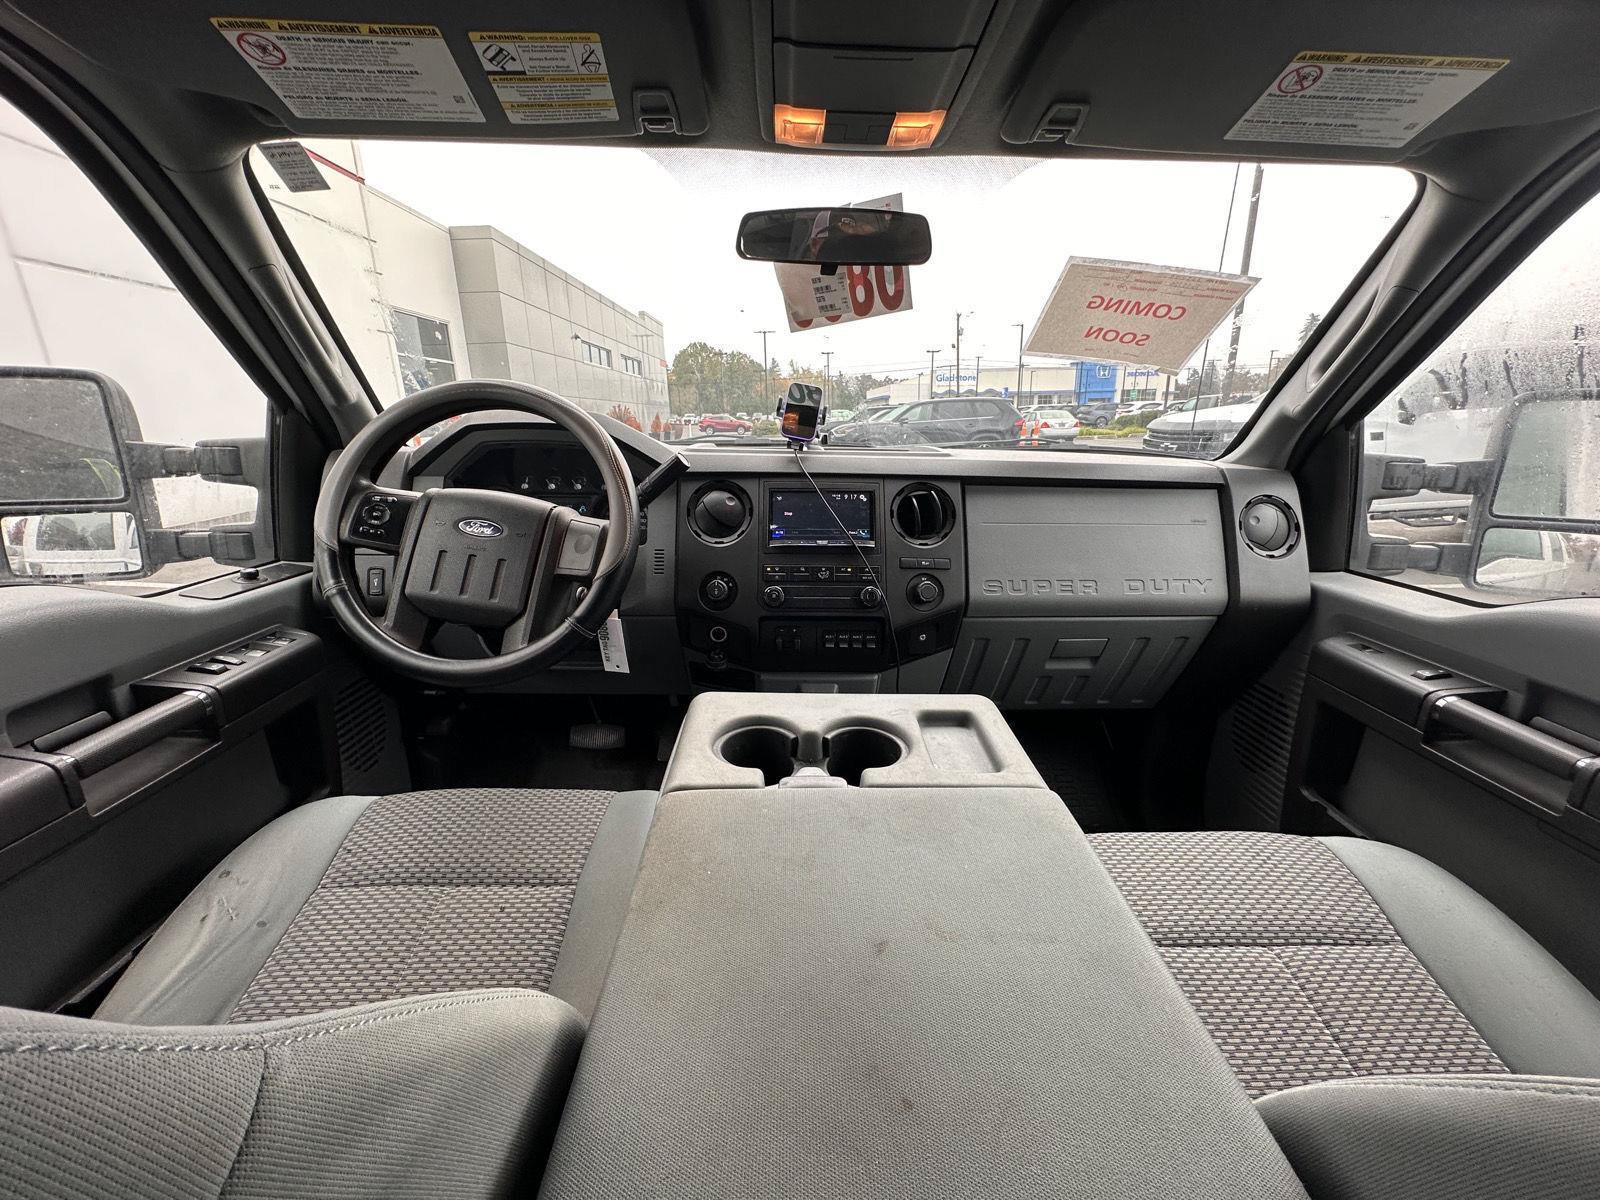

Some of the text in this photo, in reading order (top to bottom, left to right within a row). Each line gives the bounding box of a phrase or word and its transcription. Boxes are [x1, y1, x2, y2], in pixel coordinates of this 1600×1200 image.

[226, 20, 271, 31] WARNING
[287, 22, 362, 34] AVERTISSEMENT
[378, 27, 439, 37] ADVERTENCIA
[464, 521, 494, 536] Ford
[982, 578, 1213, 596] SUPER DUTY
